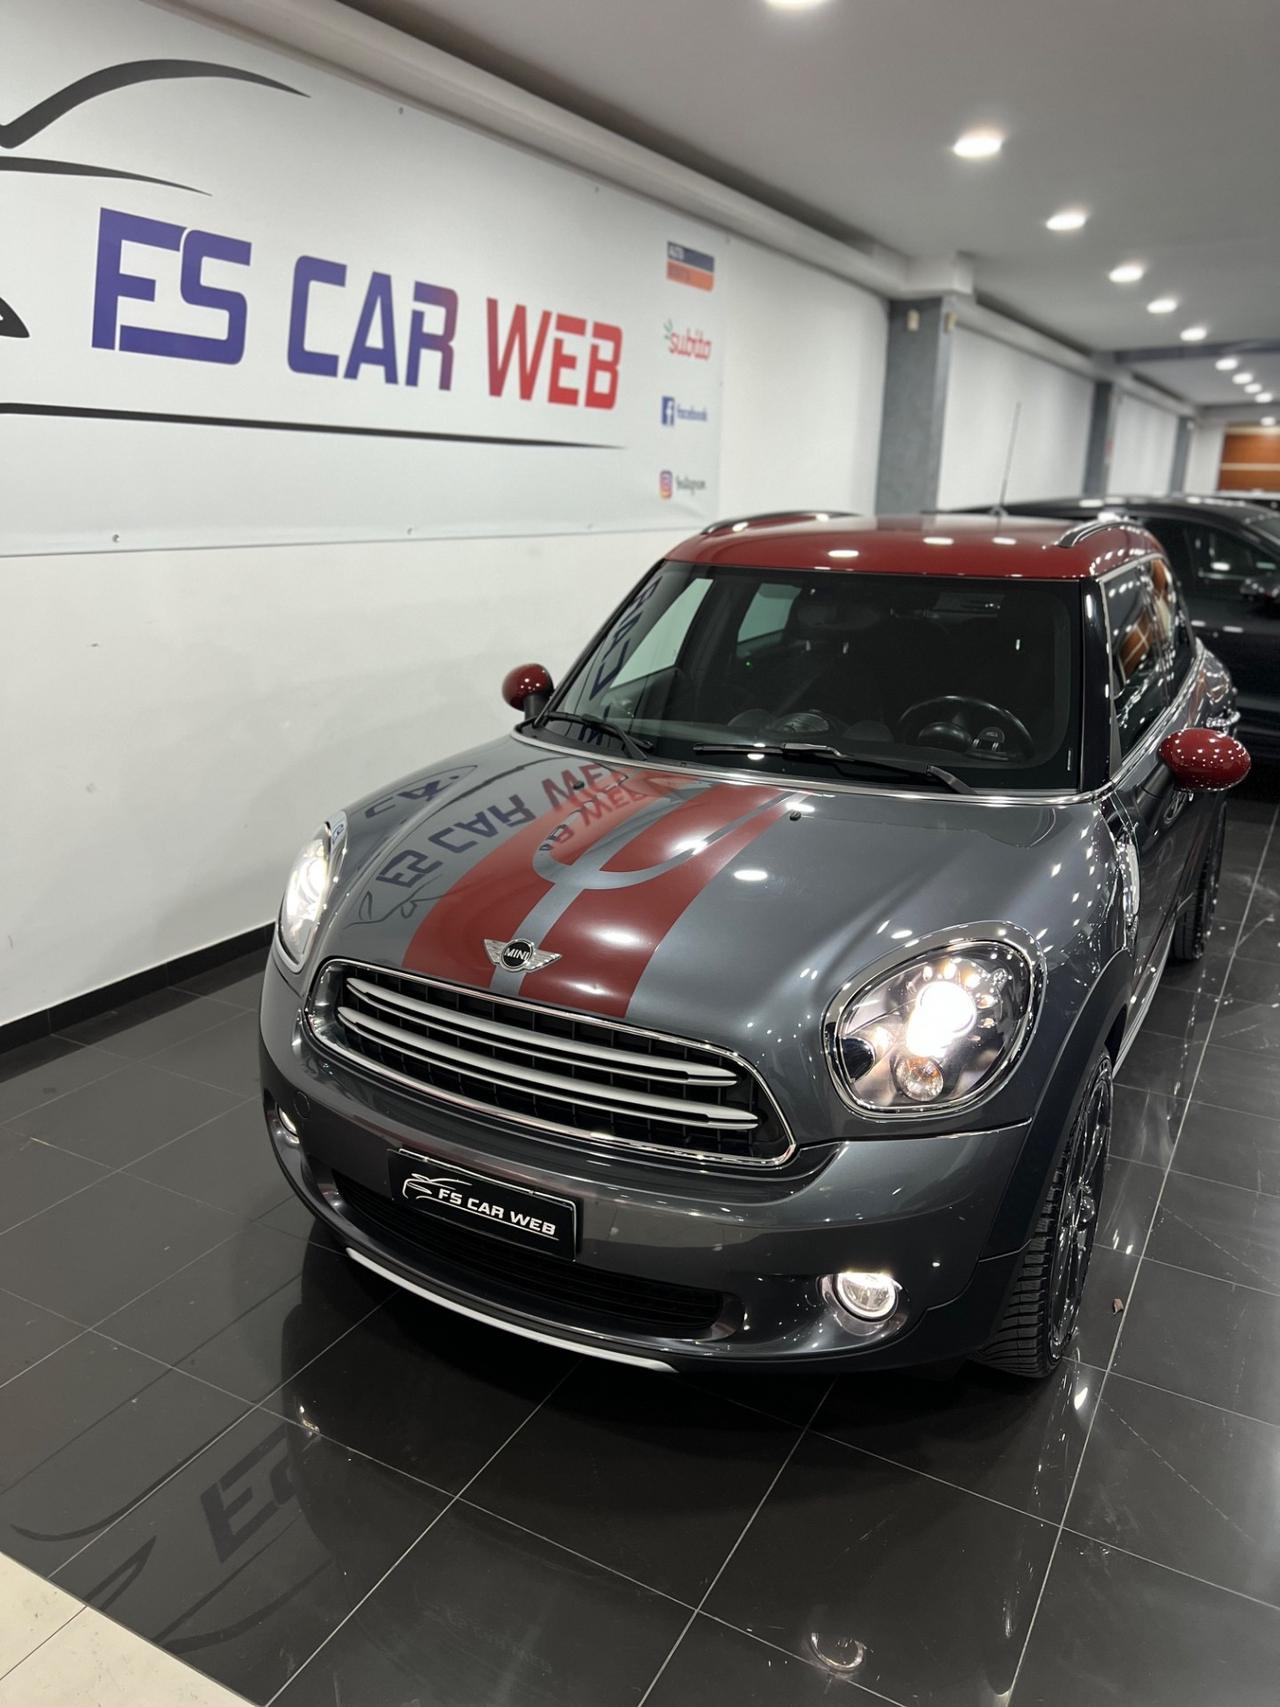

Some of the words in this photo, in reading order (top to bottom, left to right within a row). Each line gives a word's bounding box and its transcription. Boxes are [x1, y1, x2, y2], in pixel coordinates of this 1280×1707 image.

[287, 254, 459, 391] CAR
[486, 297, 623, 410] WEB
[669, 329, 711, 360] subito
[504, 947, 530, 962] MINI
[467, 1198, 504, 1218] CAR
[510, 1211, 556, 1235] WEB
